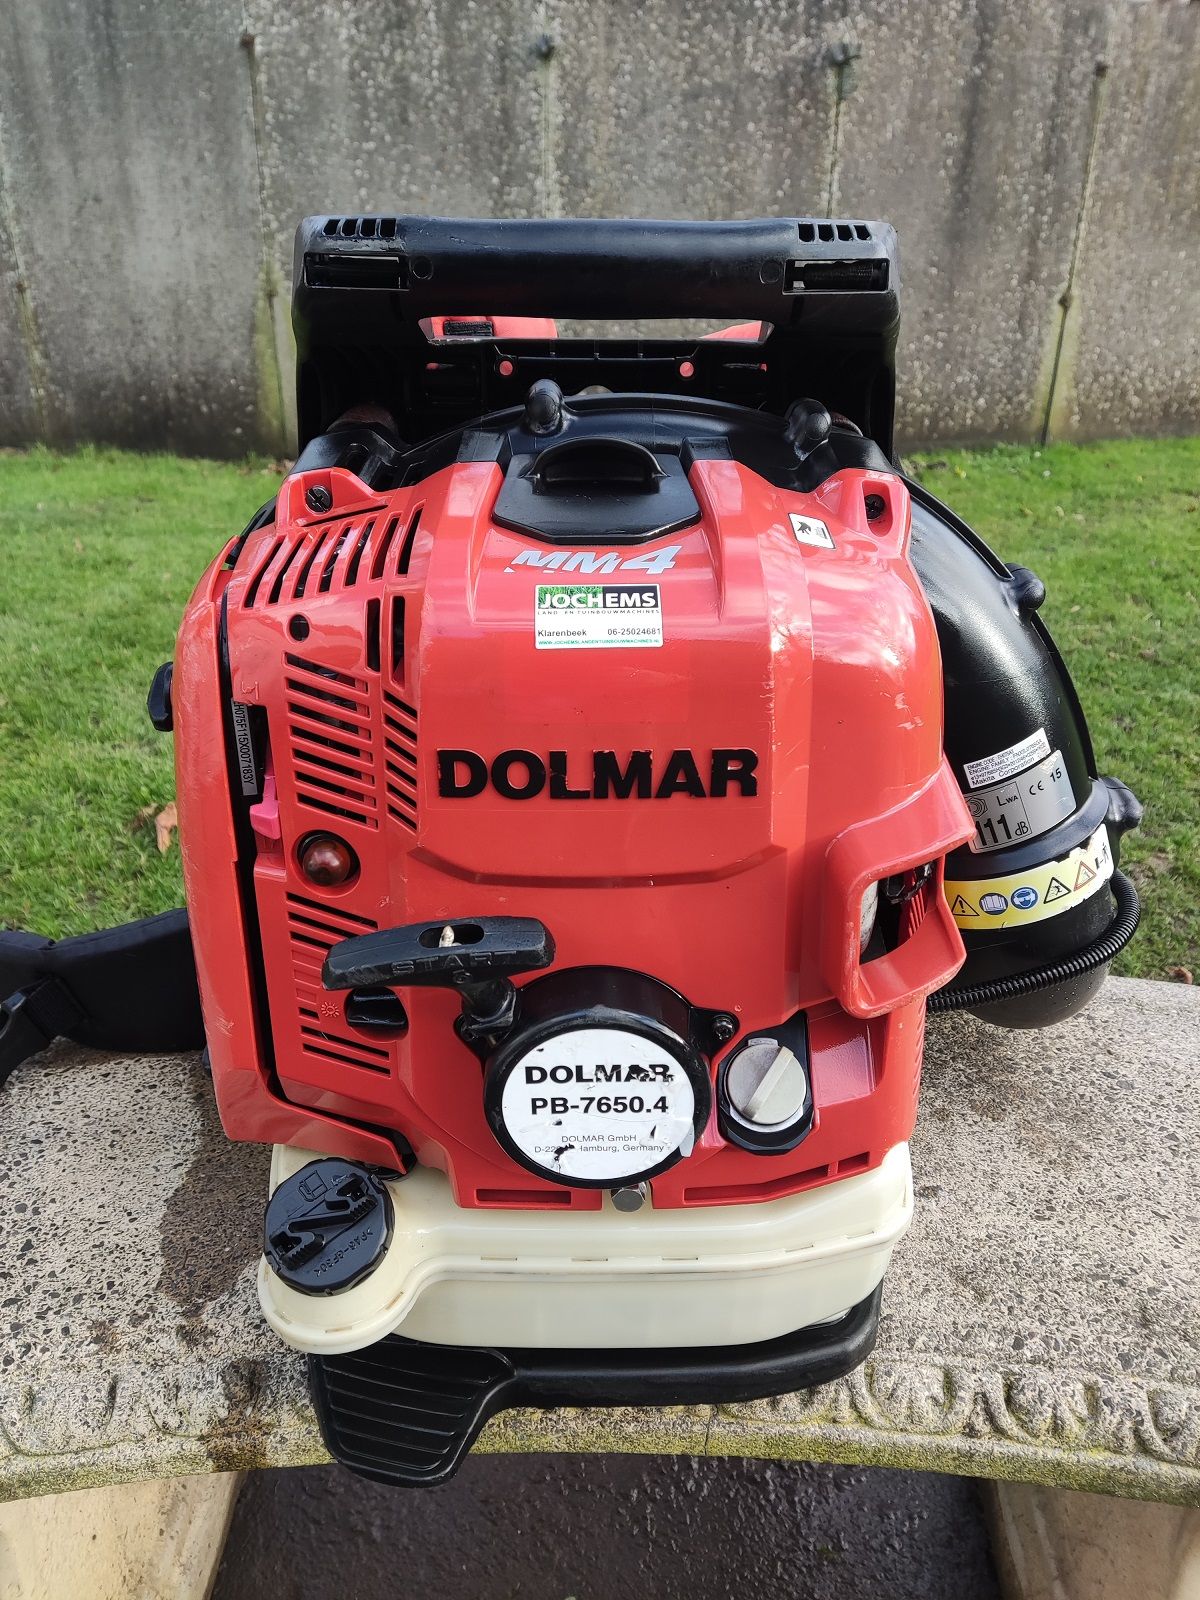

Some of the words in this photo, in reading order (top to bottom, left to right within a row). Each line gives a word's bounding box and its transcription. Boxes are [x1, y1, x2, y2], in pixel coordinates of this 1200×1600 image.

[540, 592, 655, 609] JOCHEMS
[537, 629, 587, 638] Klarenbeek
[607, 627, 661, 636] 06-25024681
[436, 748, 759, 799] DOLMAR
[971, 775, 996, 786] Makita
[998, 756, 1035, 777] Corporation
[1050, 768, 1062, 783] 15
[976, 814, 1012, 847] 111
[1014, 821, 1029, 836] dB
[525, 1064, 674, 1085] DOLMAR
[531, 1095, 669, 1115] PB-7650.4
[561, 1135, 605, 1143] DOLMAR
[607, 1134, 637, 1142] GmbH
[622, 1144, 665, 1153] Germany
